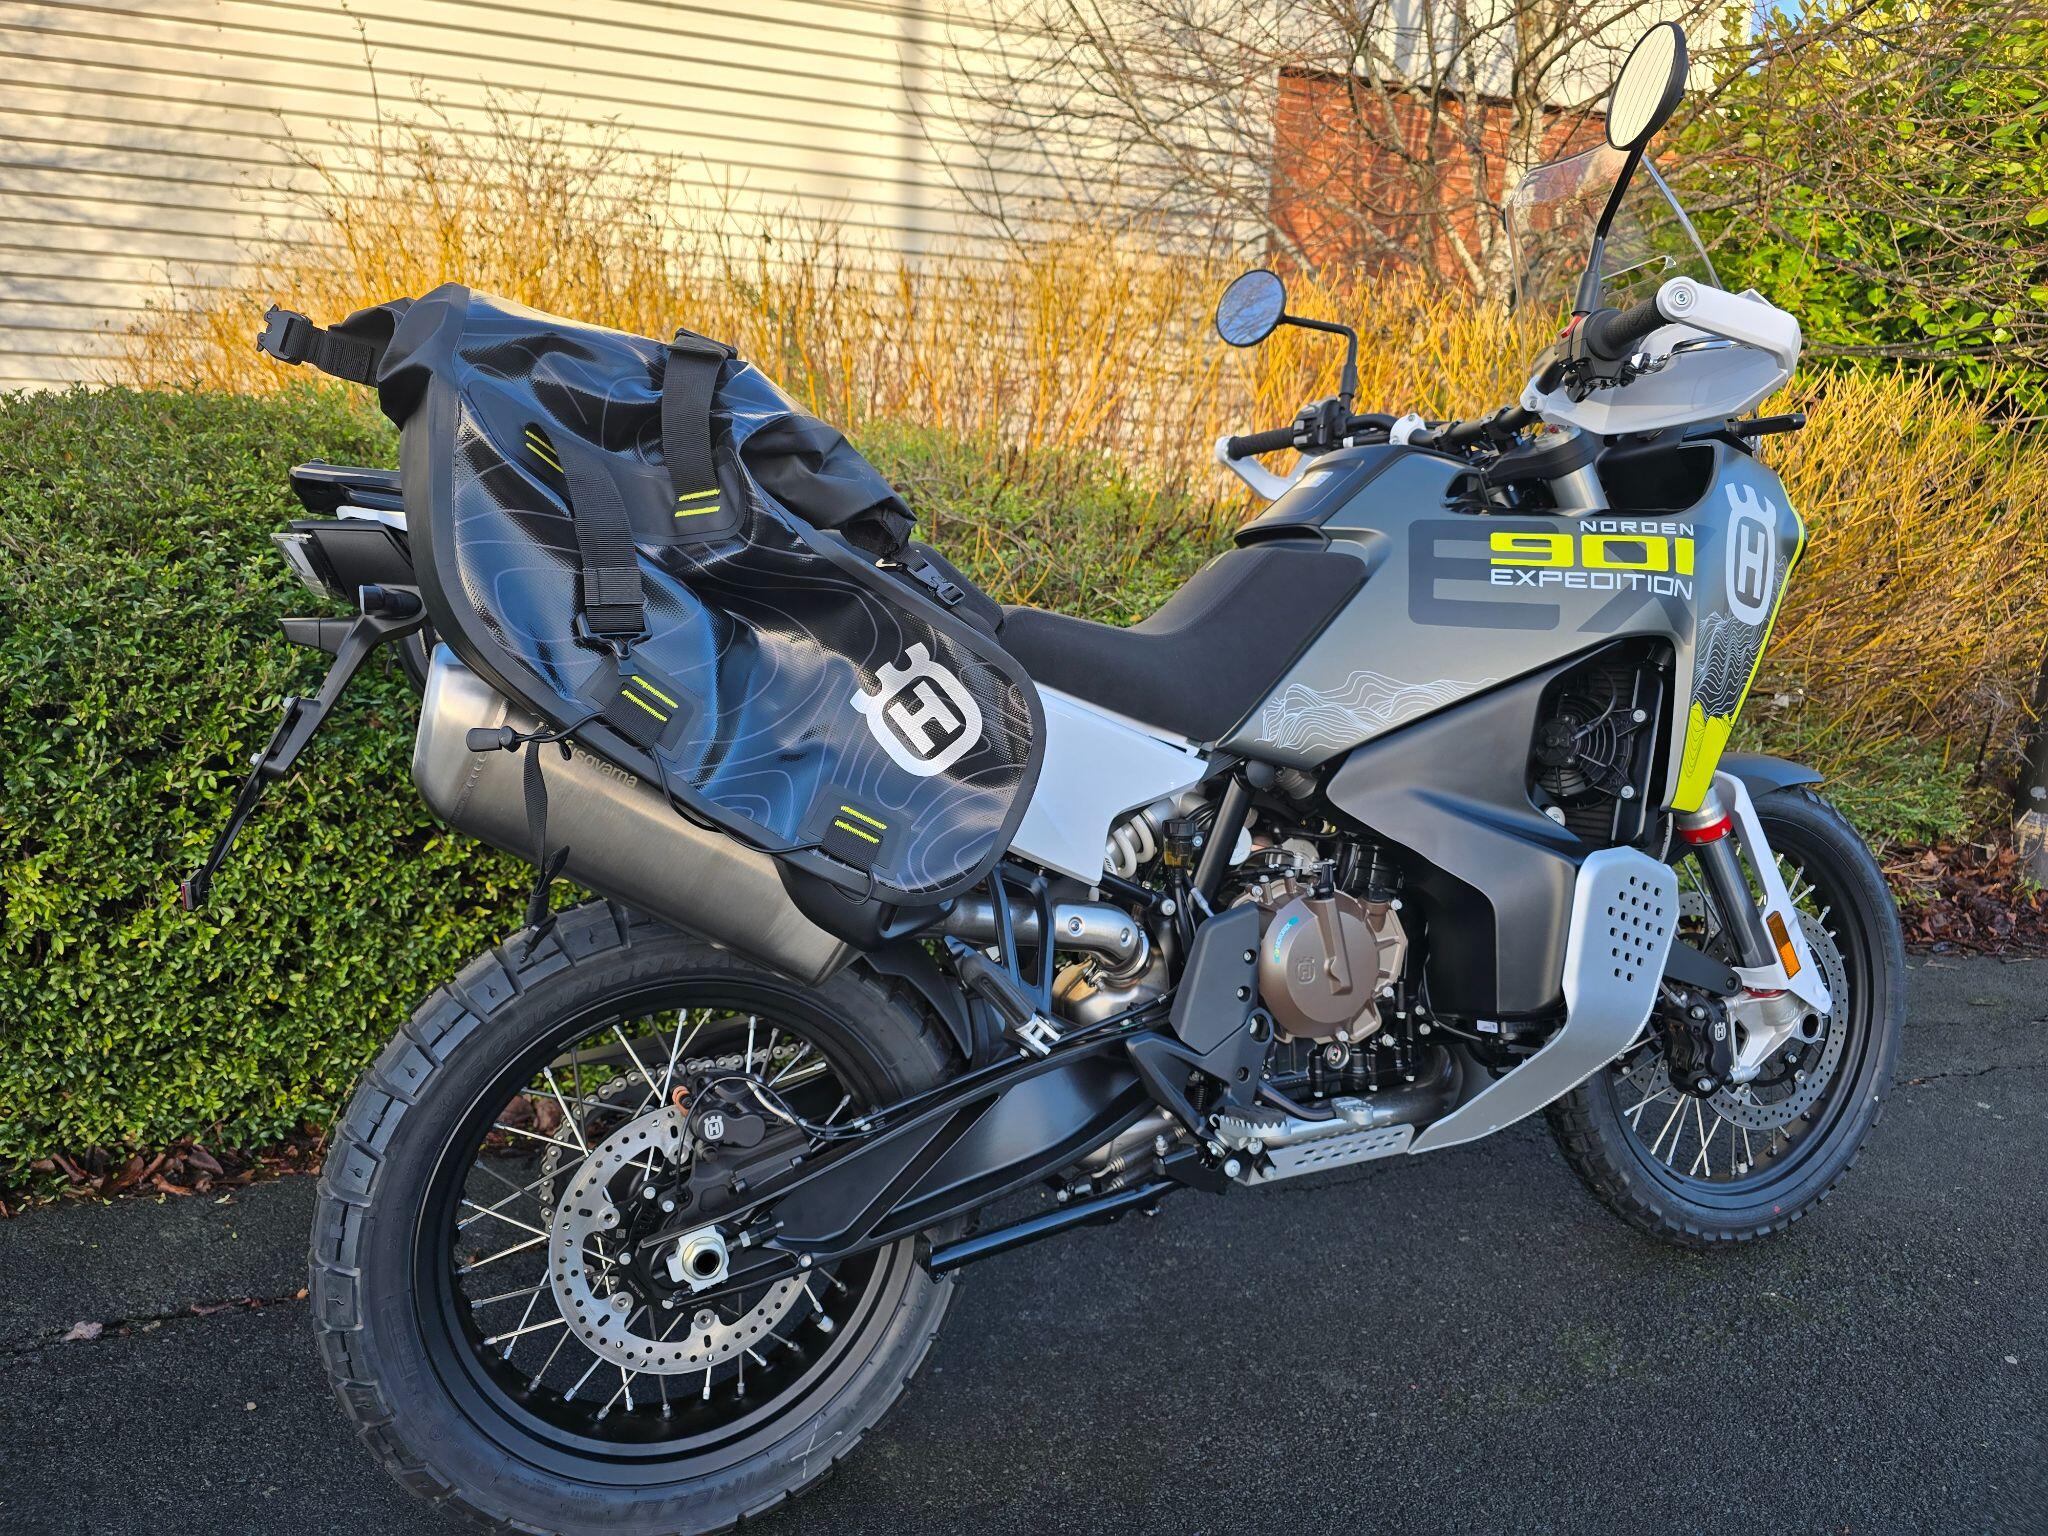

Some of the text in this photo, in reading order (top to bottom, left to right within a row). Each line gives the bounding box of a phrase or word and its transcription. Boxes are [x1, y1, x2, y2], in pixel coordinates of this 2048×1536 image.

[1580, 520, 1694, 536] NORDEN
[1490, 532, 1695, 576] 901
[1490, 568, 1693, 600] EXPEDITION
[568, 746, 638, 789] sqvarna
